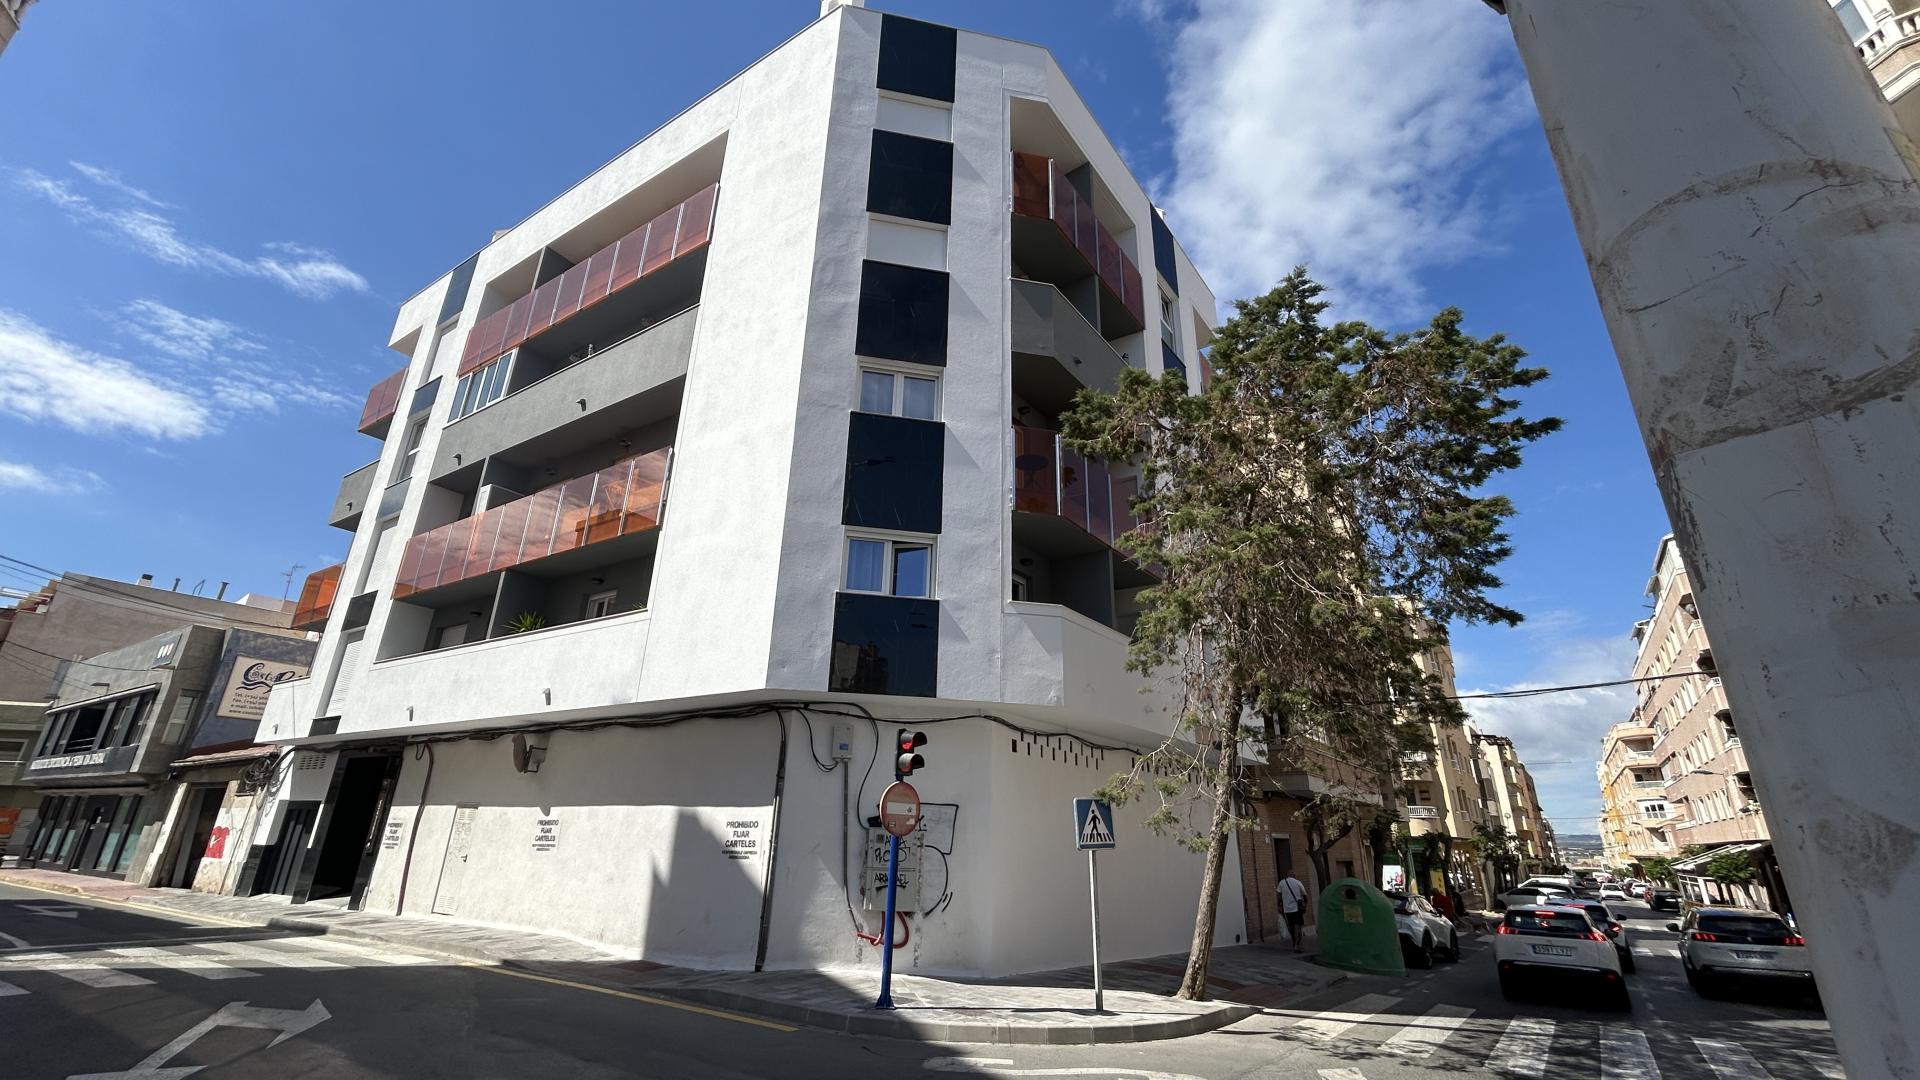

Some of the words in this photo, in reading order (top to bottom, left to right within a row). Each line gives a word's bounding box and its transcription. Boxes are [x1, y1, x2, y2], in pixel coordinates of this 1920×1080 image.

[726, 820, 759, 829] PROHIBIDO
[733, 830, 750, 838] FIJAR
[725, 840, 756, 848] CARTELES
